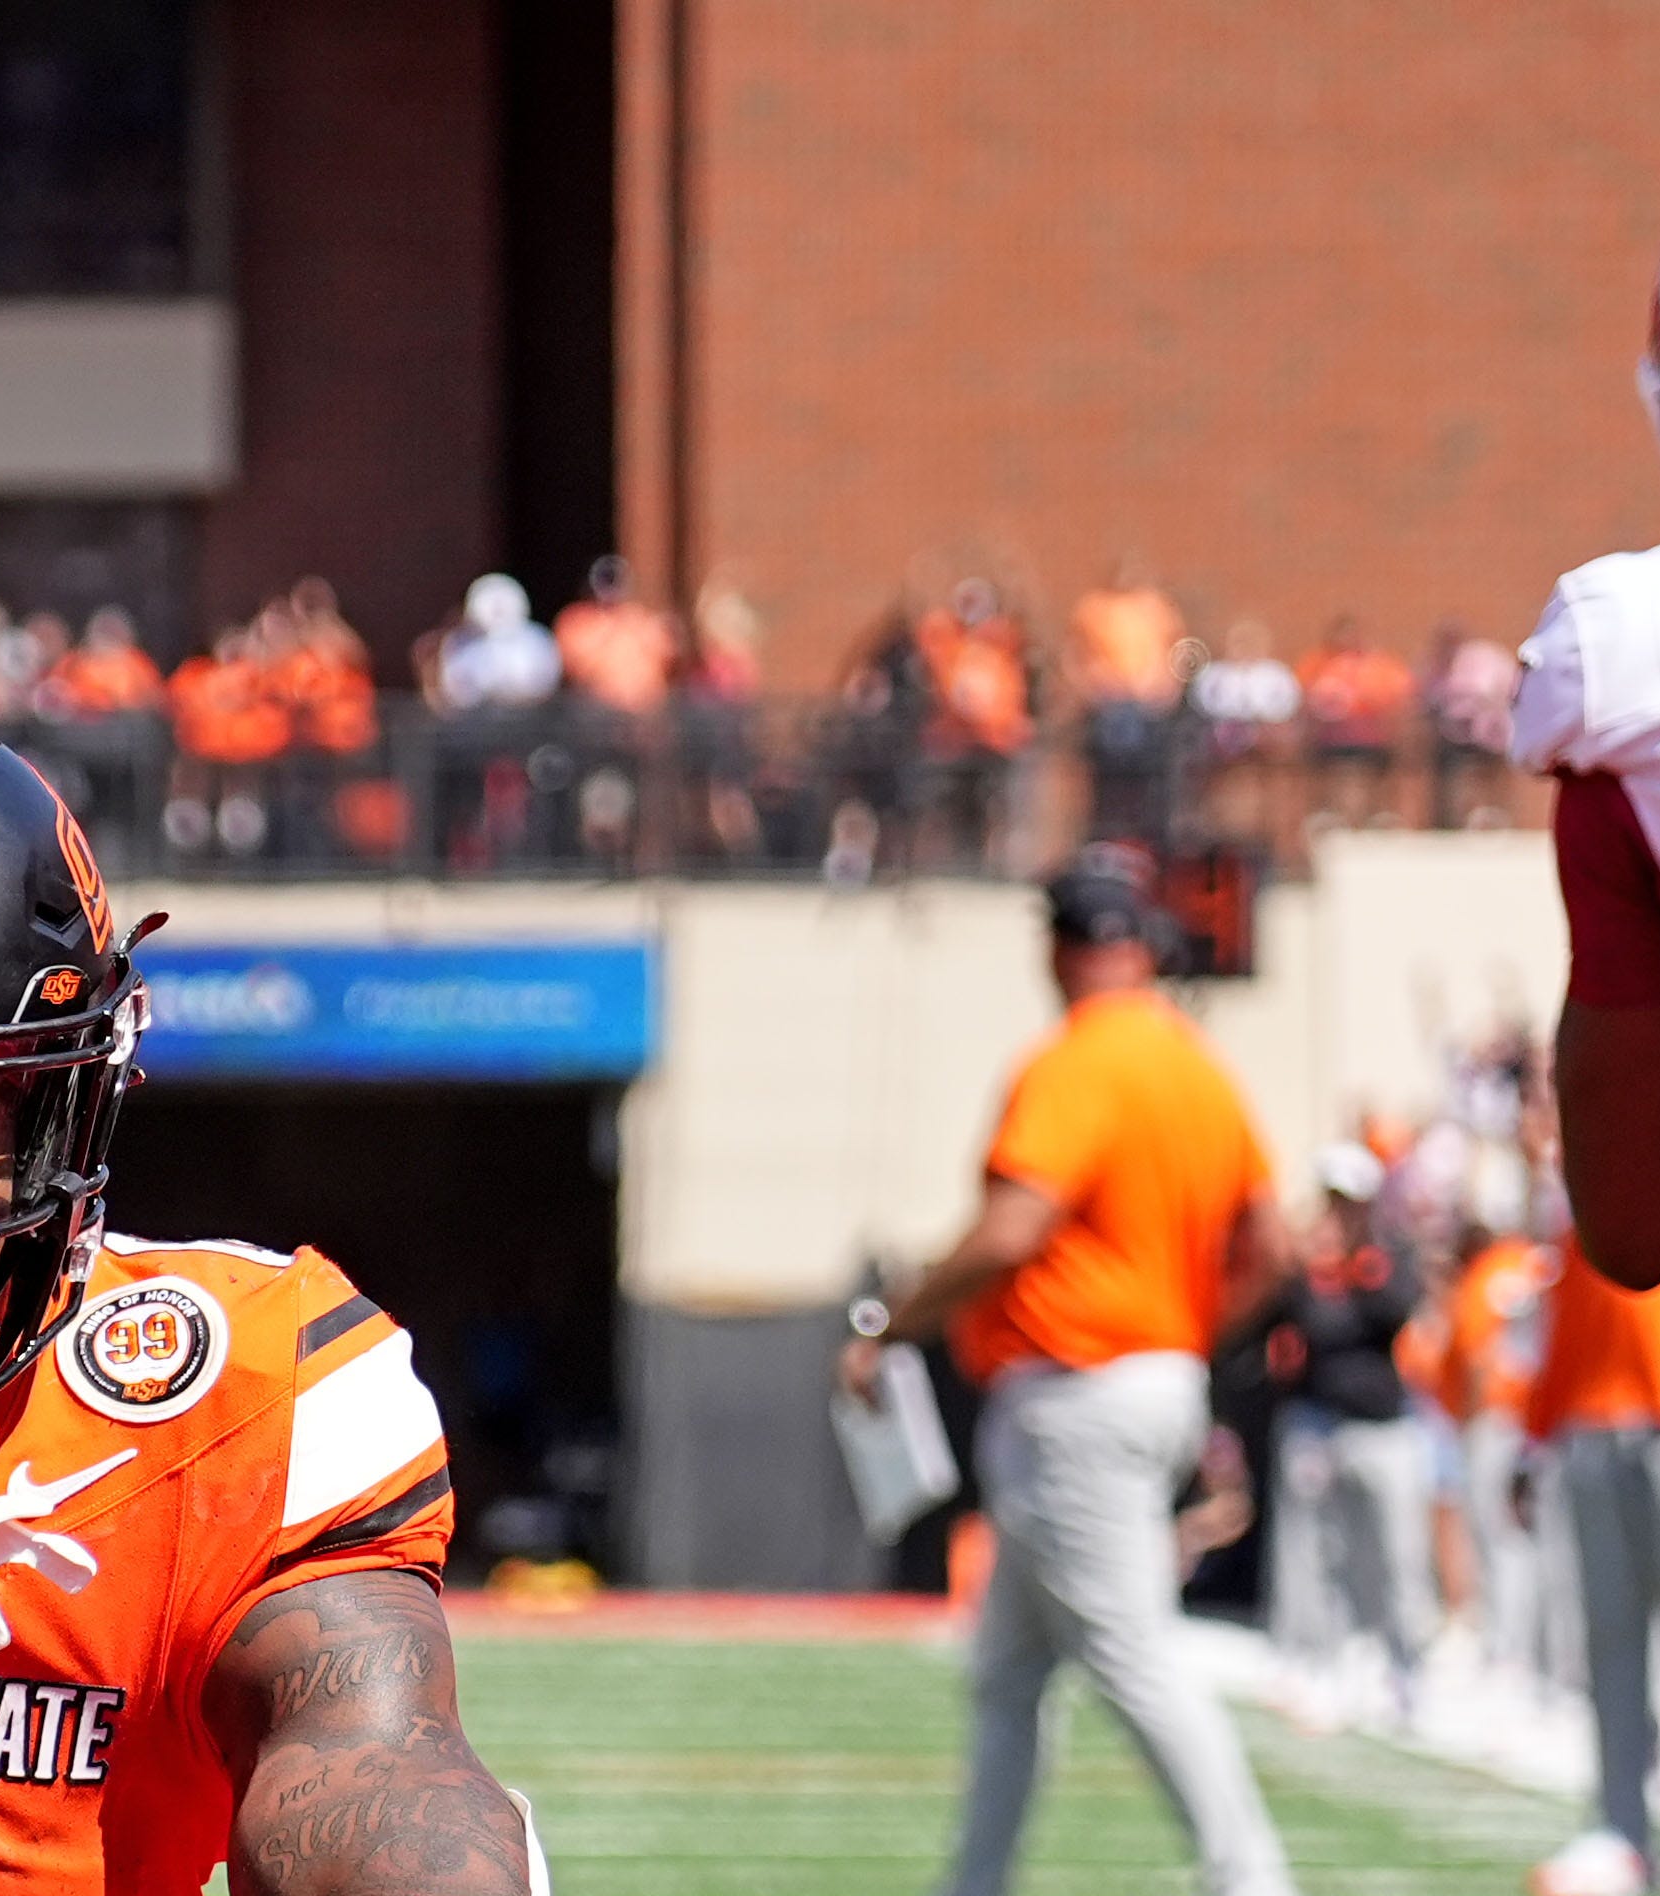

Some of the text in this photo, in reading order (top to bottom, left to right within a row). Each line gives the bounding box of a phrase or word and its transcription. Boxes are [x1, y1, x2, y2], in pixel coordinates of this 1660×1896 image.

[39, 969, 82, 1005] OSU
[80, 1289, 199, 1335] RING OF HONOR
[105, 1311, 178, 1365] 99
[271, 1631, 433, 1722] Walk
